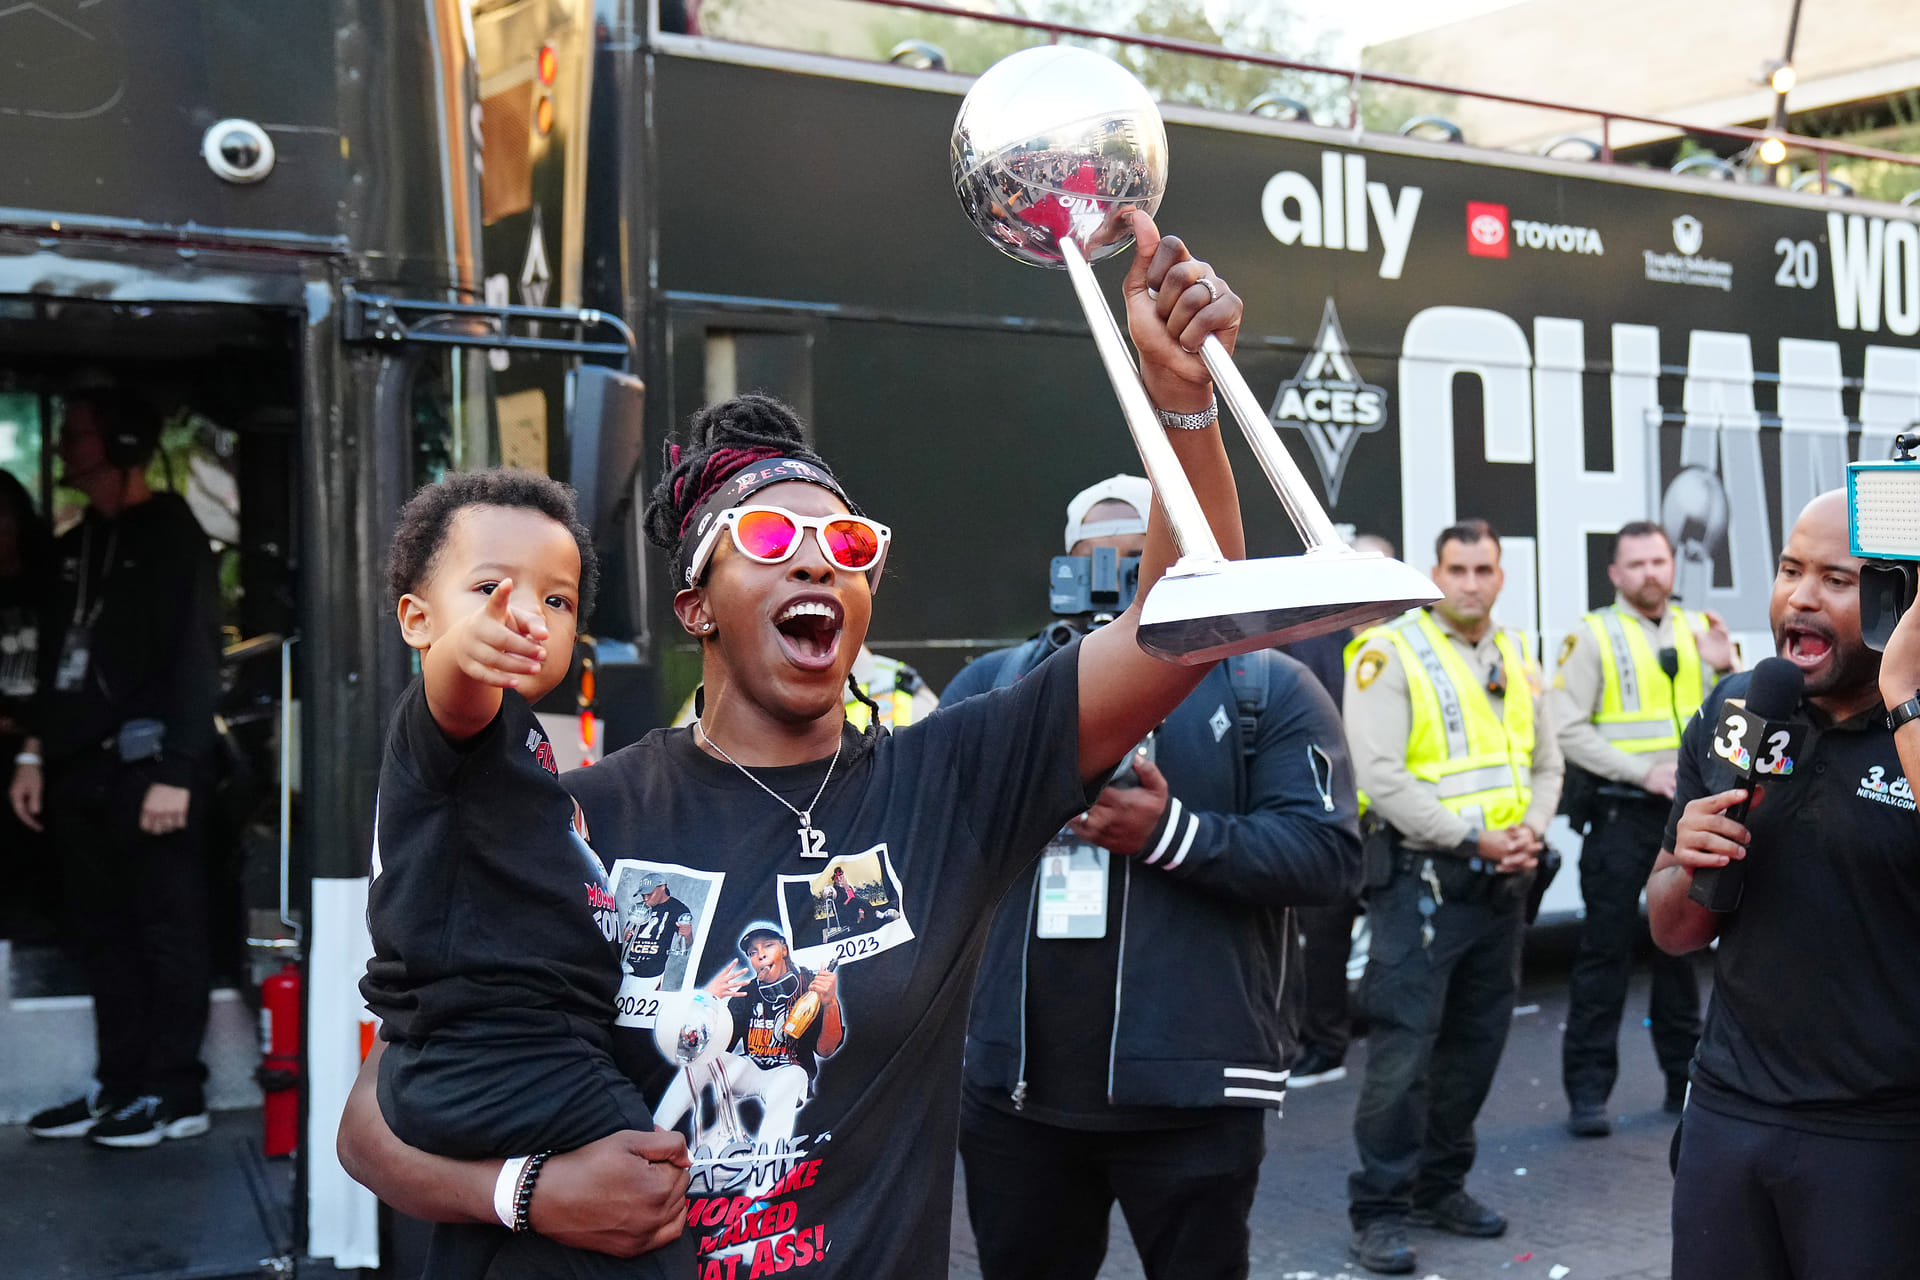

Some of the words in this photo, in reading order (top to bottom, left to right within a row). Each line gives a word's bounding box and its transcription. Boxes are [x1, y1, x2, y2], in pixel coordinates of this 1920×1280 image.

[1261, 151, 1423, 279] ally
[1512, 220, 1604, 256] TOYOTA
[1774, 237, 1819, 289] 20
[1277, 388, 1381, 425] ACES
[1713, 714, 1748, 759] 3
[1755, 730, 1791, 774] 3
[1860, 765, 1885, 789] 3
[797, 828, 829, 858] 12
[835, 936, 880, 959] 2023
[614, 996, 659, 1017] 2022
[685, 1195, 753, 1227] MOR
[697, 1253, 742, 1280] AT
[749, 1224, 825, 1280] ASS!
